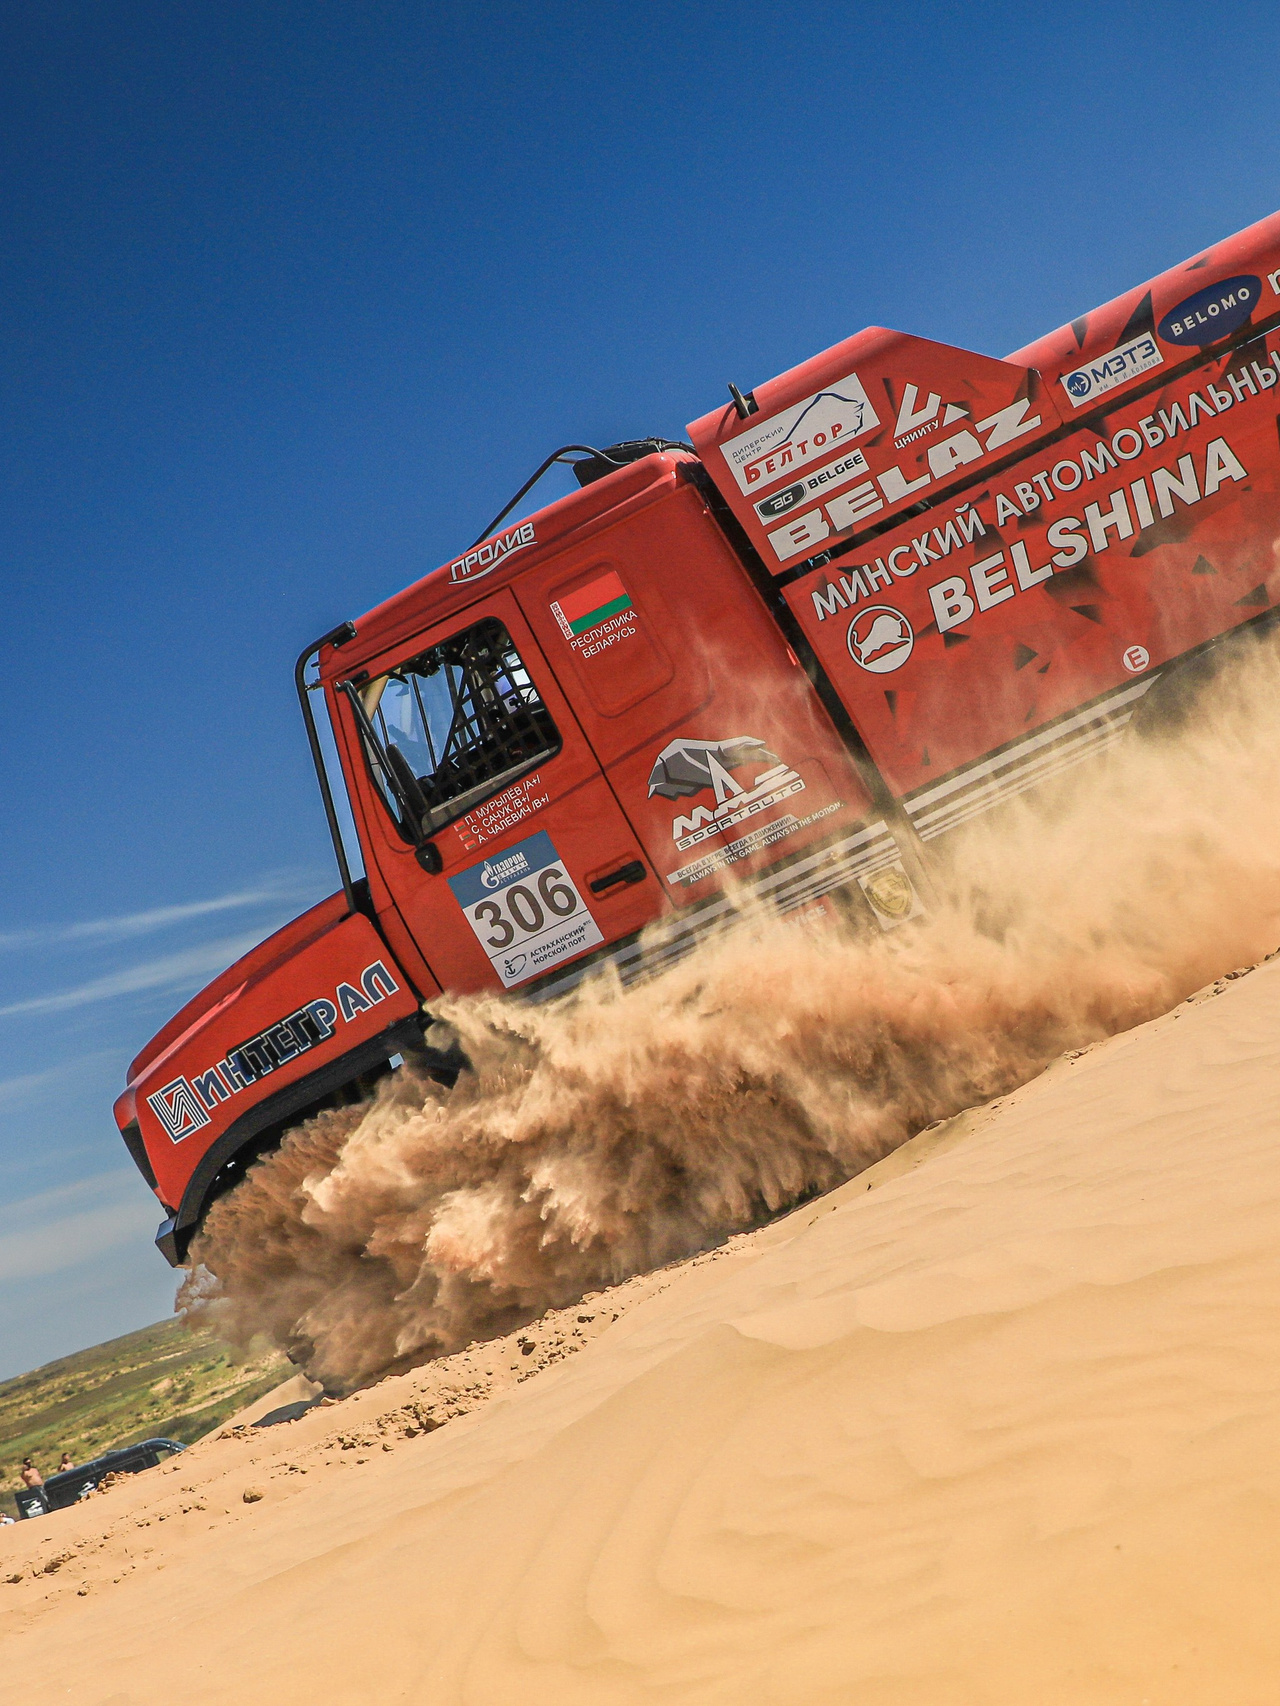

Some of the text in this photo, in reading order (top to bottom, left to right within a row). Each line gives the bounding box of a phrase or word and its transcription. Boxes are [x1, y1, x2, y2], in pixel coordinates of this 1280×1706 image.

[1170, 287, 1250, 337] BELOMO
[1091, 338, 1156, 384] МЭТЗ
[731, 426, 785, 459] ДИЛЕРСКИЙ
[743, 423, 843, 485] БЕЛТОР
[894, 419, 939, 450] ЦНИИТУ
[735, 446, 763, 465] ЦЕНТР
[807, 453, 864, 490] BELGEE
[766, 397, 1042, 562] BELAZ
[451, 522, 535, 581] ПРОЛИВ
[928, 436, 1248, 633] BELSHINA
[811, 502, 987, 621] МИНСКИЙ
[570, 610, 638, 651] РЕСПУБЛИКА
[581, 625, 637, 659] БЕЛАРУСЬ
[464, 815, 477, 826] П.
[475, 786, 522, 818] МУРЫЛЁВ
[471, 825, 482, 834] С.
[482, 807, 513, 828] САЧУК
[478, 834, 489, 843] А.
[487, 806, 532, 835] ЧАЛЕВИЧ
[679, 781, 803, 849] SPORTAUTO
[493, 852, 526, 874] ГАЗПРОМ
[688, 864, 717, 883] ALWAYS
[760, 827, 790, 846] ALWAYS
[789, 822, 798, 831] IN
[797, 815, 812, 827] THE
[474, 868, 577, 948] 306
[530, 925, 585, 958] АСТРАХАНСКИЙ
[533, 934, 586, 966] МОРСКОЙ ПОРТ
[190, 959, 400, 1110] ИНТЕГРАЛ
